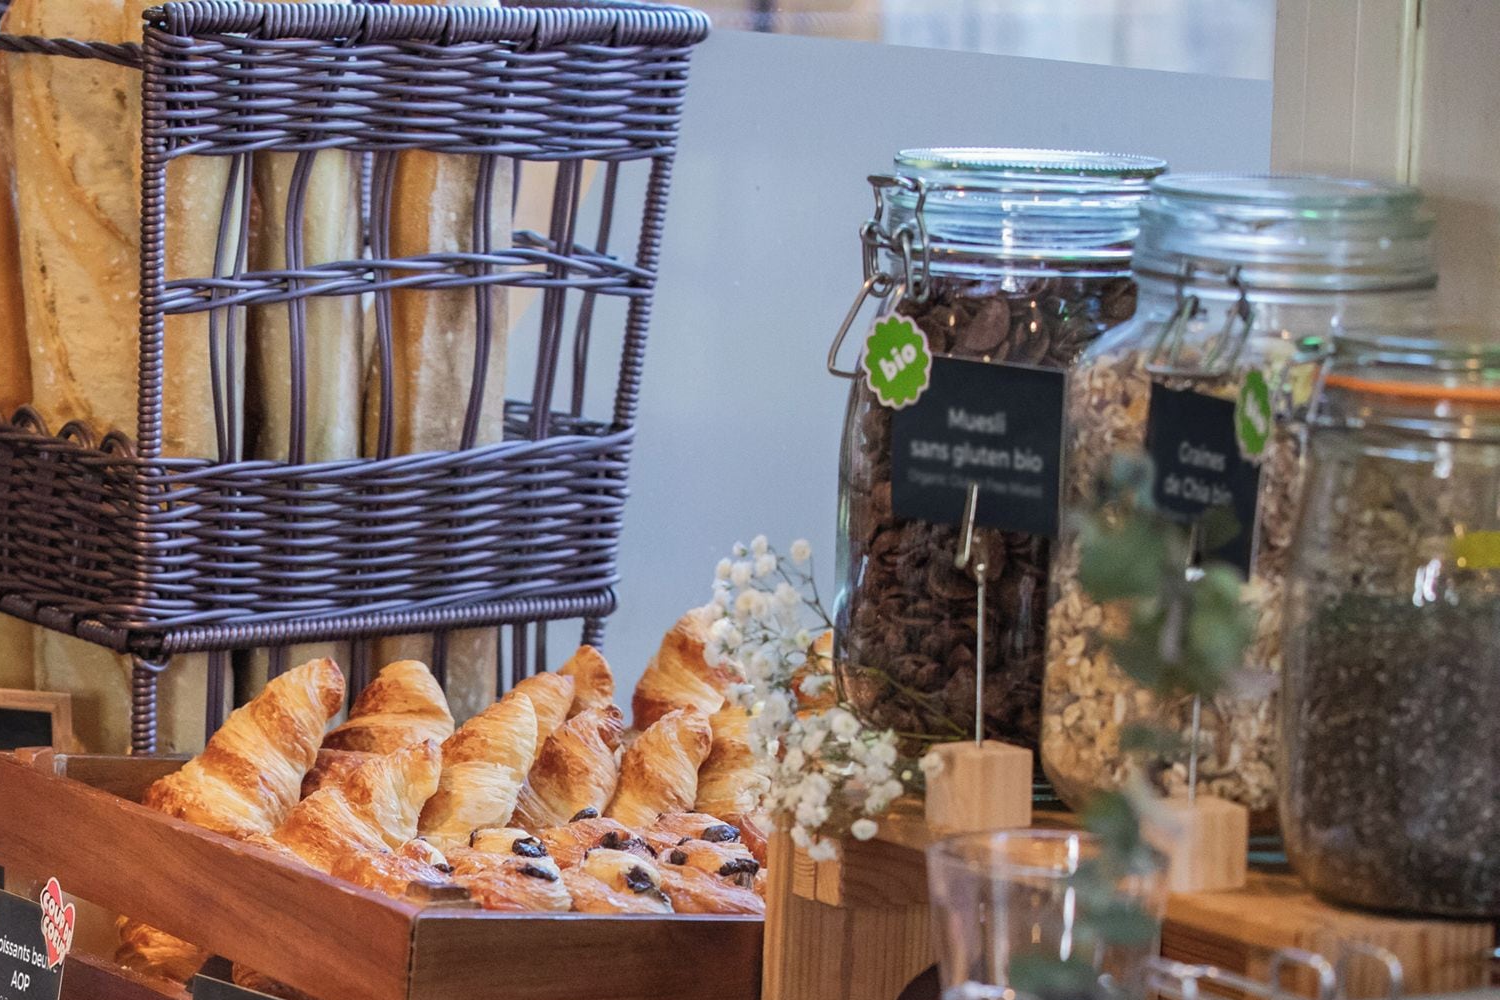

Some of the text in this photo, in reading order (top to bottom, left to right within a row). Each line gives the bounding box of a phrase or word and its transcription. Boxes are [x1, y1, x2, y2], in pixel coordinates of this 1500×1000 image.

[879, 343, 917, 382] bio
[1013, 447, 1043, 473] bio
[10, 969, 31, 992] AOP
